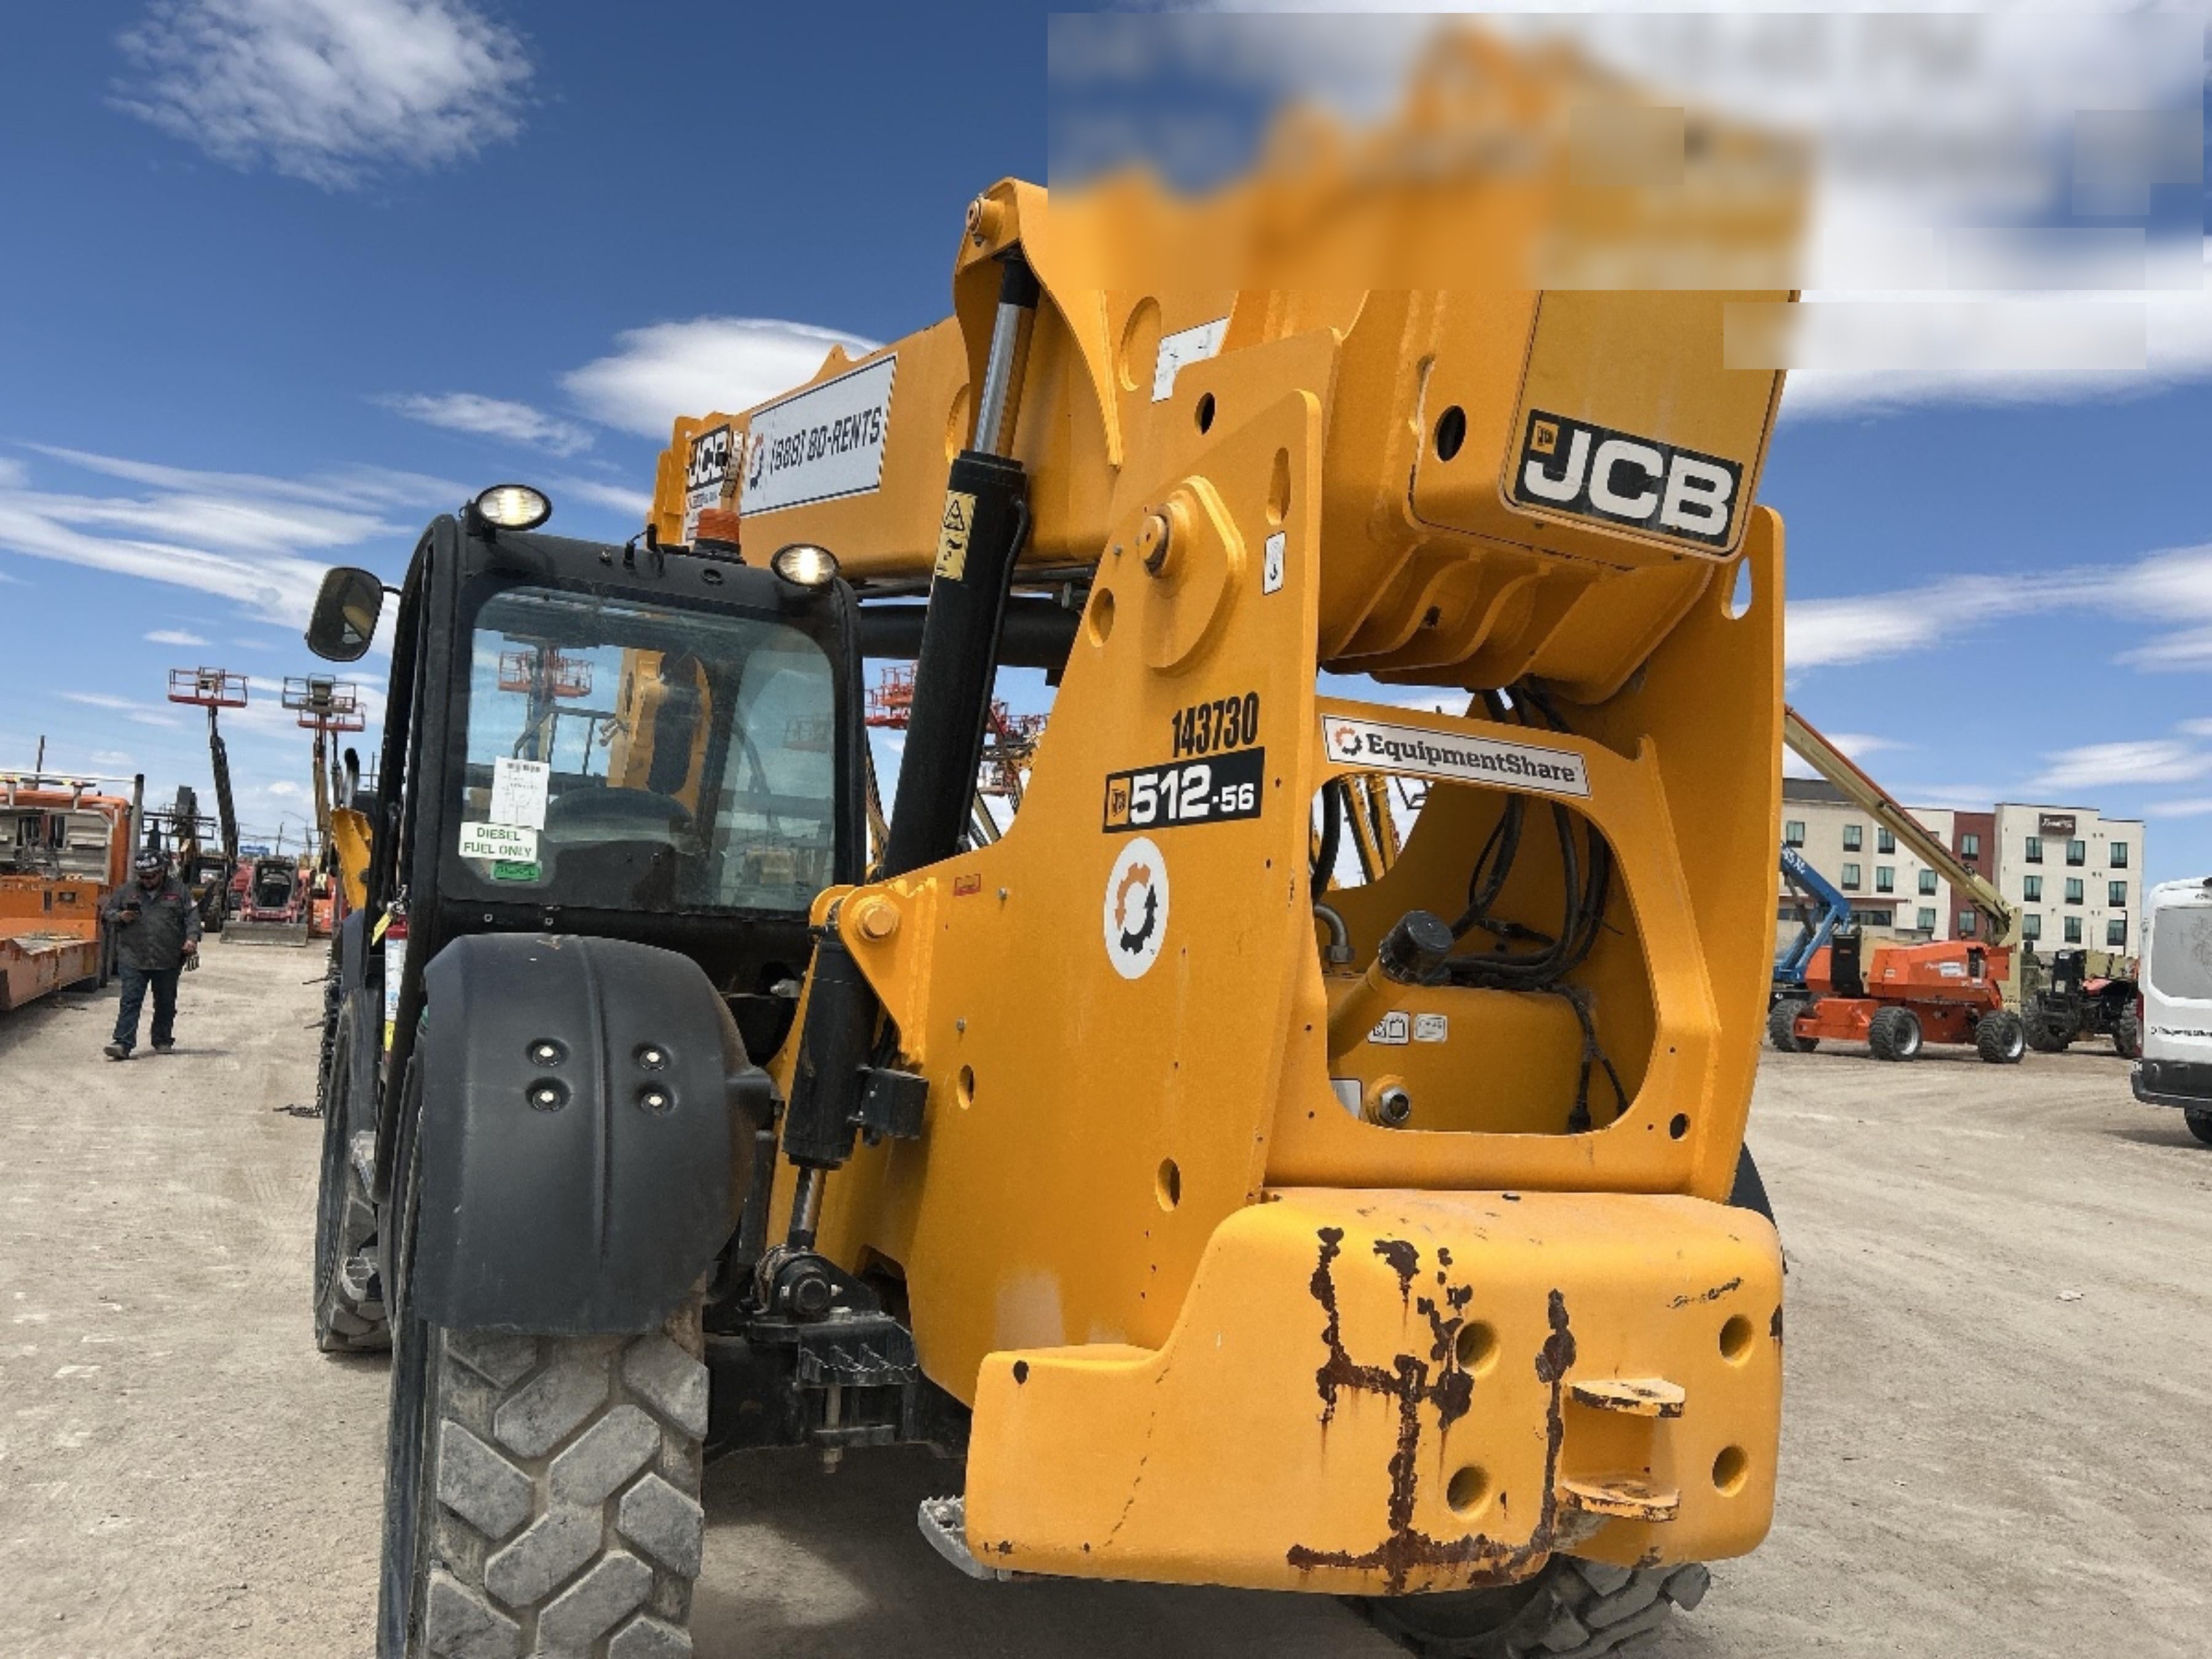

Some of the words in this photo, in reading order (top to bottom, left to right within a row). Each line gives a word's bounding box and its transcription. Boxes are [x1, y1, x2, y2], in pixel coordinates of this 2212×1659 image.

[688, 431, 728, 487] JCB
[807, 406, 882, 461] 80-RENTS
[1524, 429, 1733, 536] JCB
[1172, 691, 1260, 758] 143730
[1366, 733, 1575, 783] EquipmentShare
[463, 841, 495, 854] FUEL
[499, 845, 532, 858] ONLY
[477, 827, 521, 842] DIESEL
